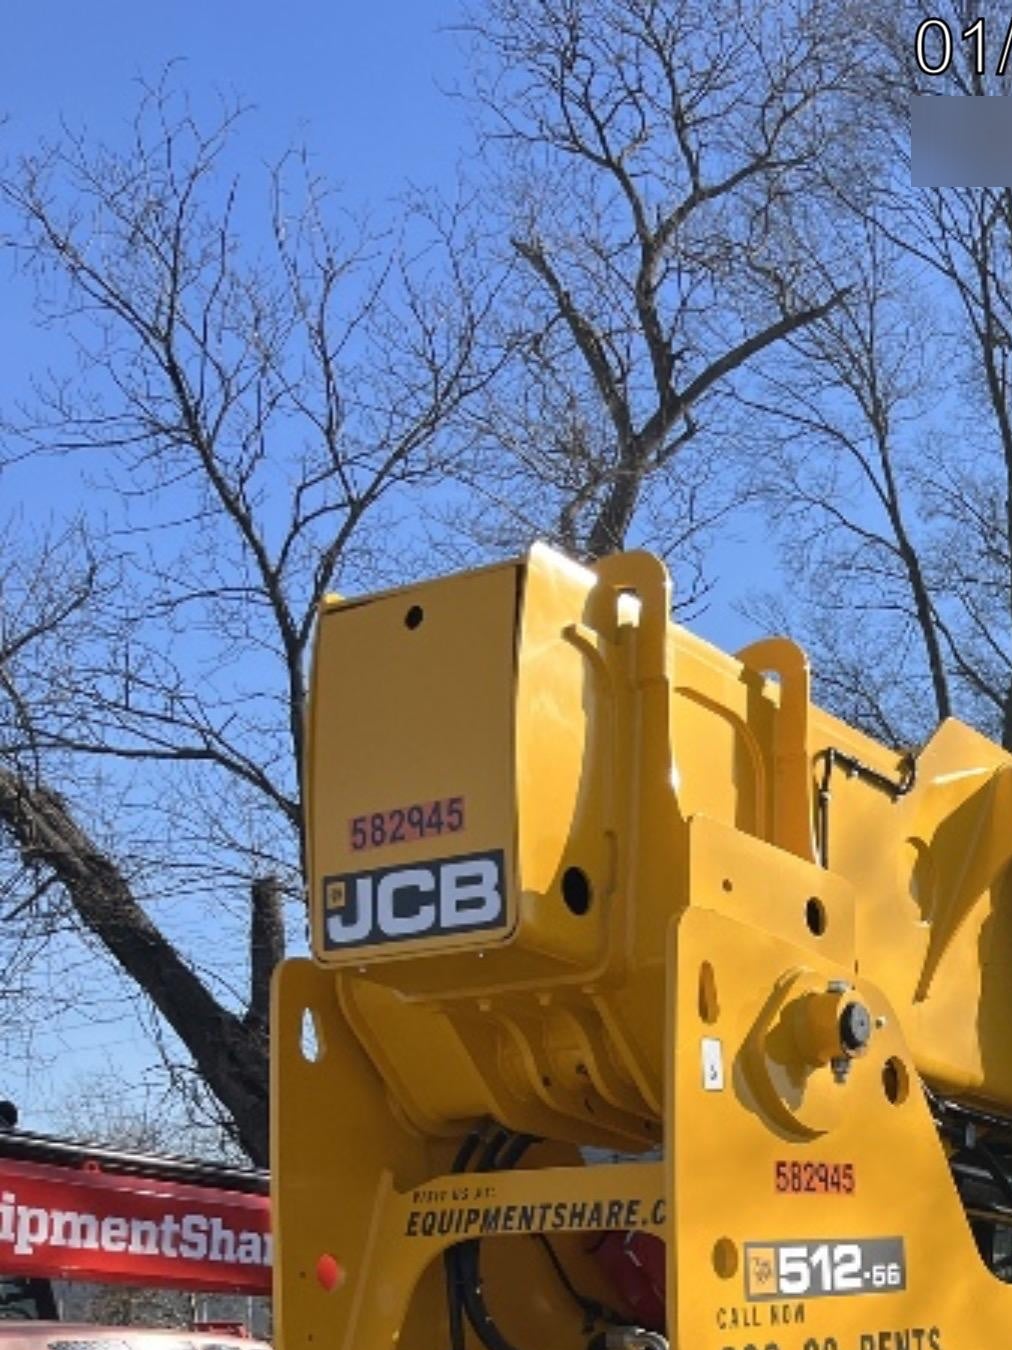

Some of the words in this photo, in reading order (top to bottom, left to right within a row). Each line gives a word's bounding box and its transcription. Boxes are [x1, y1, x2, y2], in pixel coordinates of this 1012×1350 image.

[352, 797, 464, 850] 582945
[327, 860, 501, 943] JCB
[776, 1160, 855, 1193] 582945
[717, 1304, 761, 1330] CALL
[770, 1302, 805, 1327] NOW
